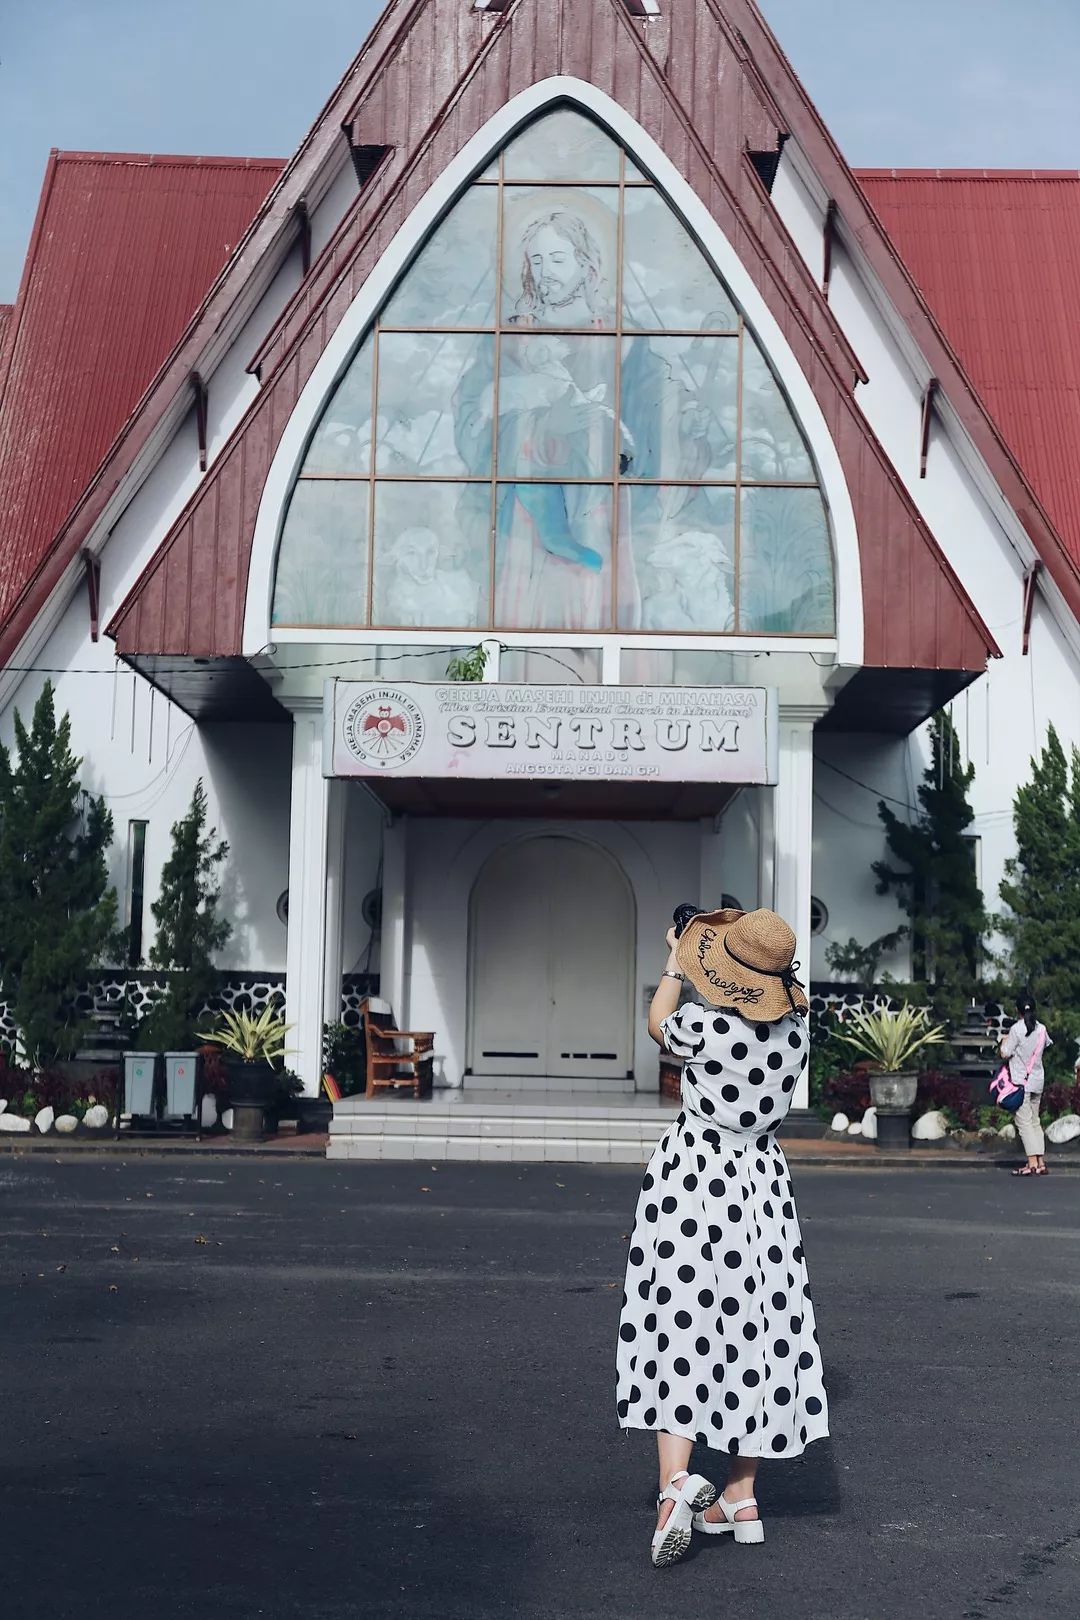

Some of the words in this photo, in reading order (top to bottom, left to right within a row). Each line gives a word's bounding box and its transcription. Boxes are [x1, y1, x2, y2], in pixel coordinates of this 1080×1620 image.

[347, 692, 376, 722] MASEHI
[379, 691, 407, 705] INJILI
[435, 687, 500, 703] GEREJA
[505, 688, 573, 704] MASEHI
[580, 690, 631, 705] INJILI
[636, 690, 652, 706] di
[659, 692, 758, 708] MINAHASA
[346, 725, 366, 760] GEREJA
[400, 713, 422, 761] MINAHASA
[446, 714, 740, 753] SENTRUM
[551, 750, 629, 762] MANADO
[505, 763, 574, 775] ANGGOTA
[577, 764, 600, 776] PGI
[604, 765, 633, 776] DAN
[636, 765, 660, 777] GPI
